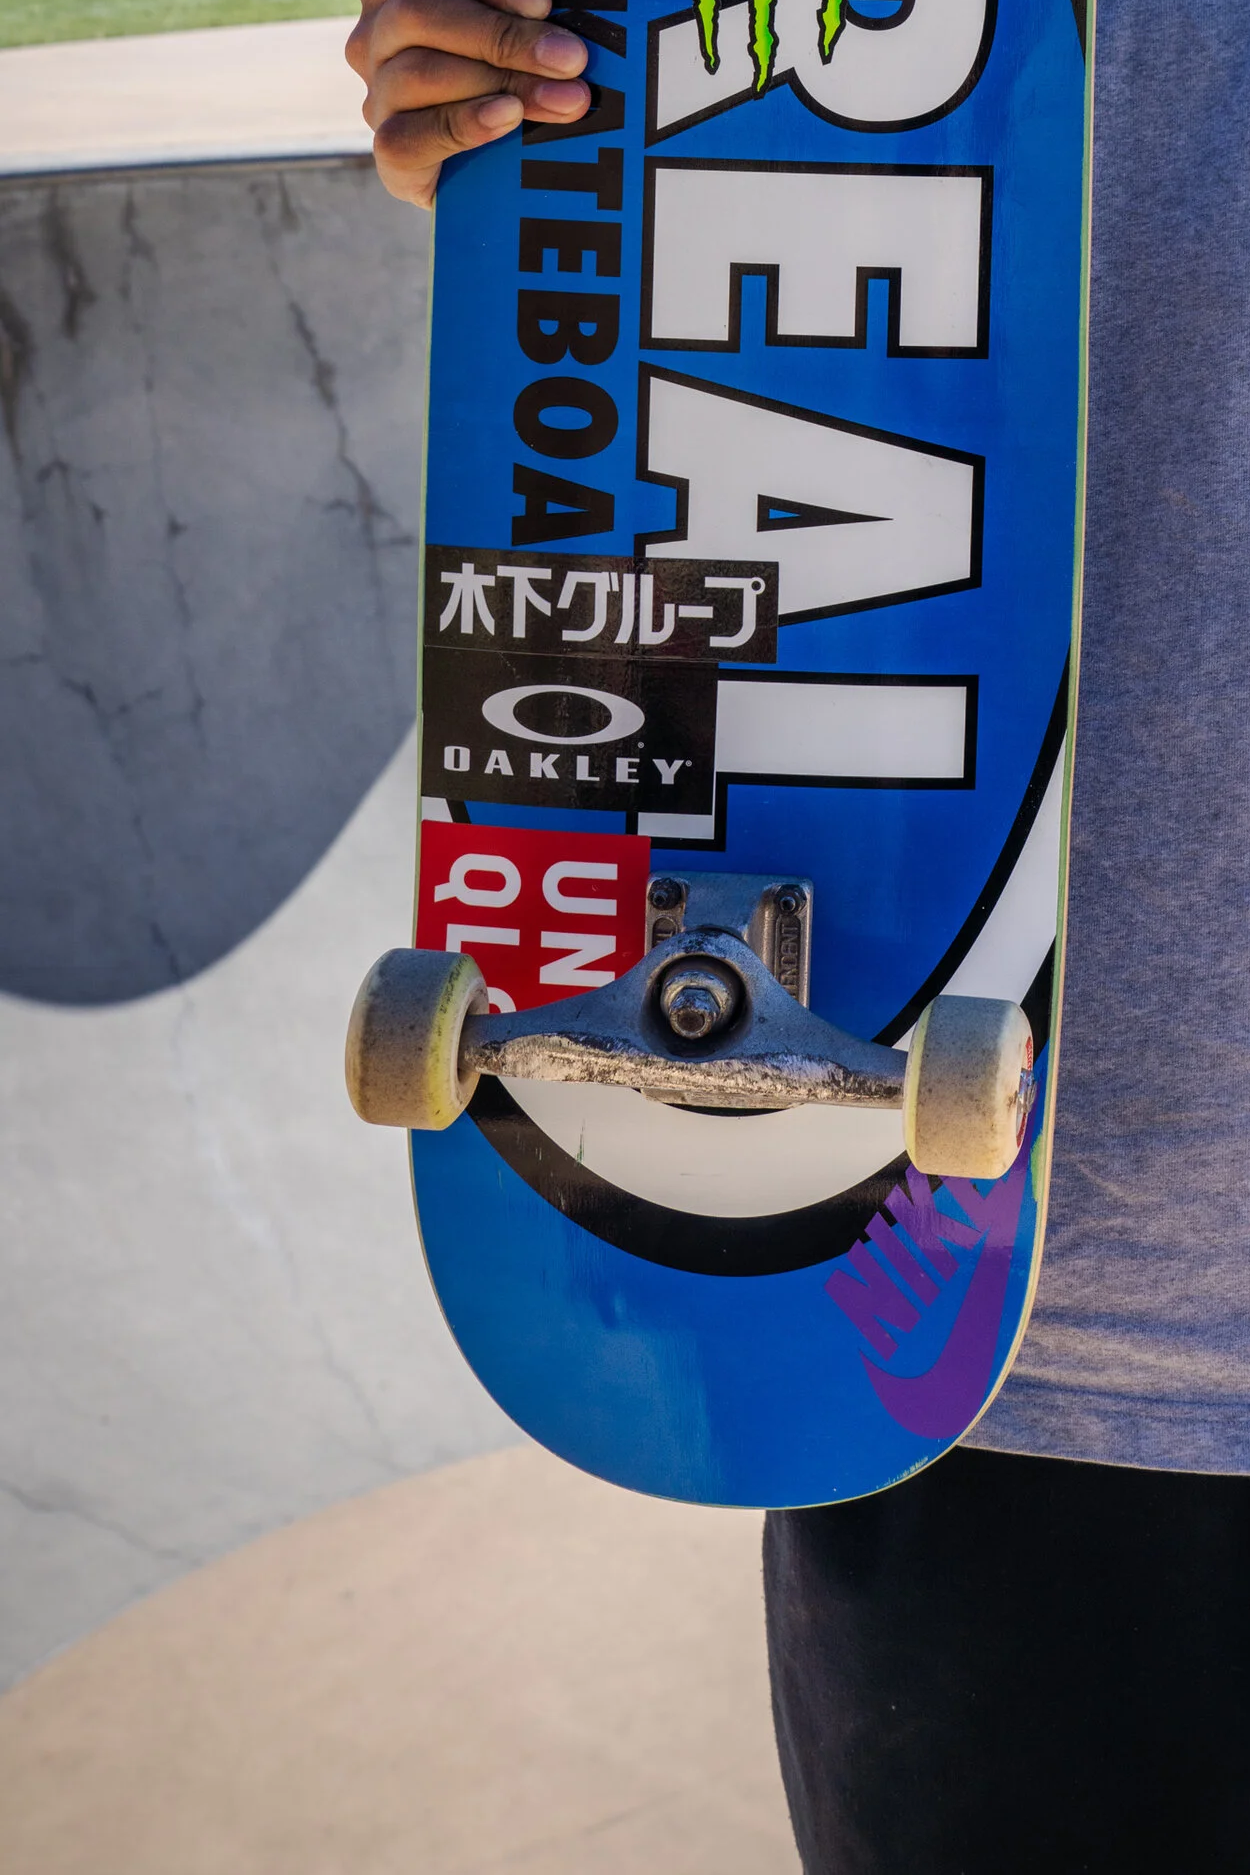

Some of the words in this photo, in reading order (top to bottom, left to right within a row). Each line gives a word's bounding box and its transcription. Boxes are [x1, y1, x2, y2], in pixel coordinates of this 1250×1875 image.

[439, 562, 766, 649] 木下グループ
[433, 853, 522, 1013] QL
[538, 860, 619, 988] UN
